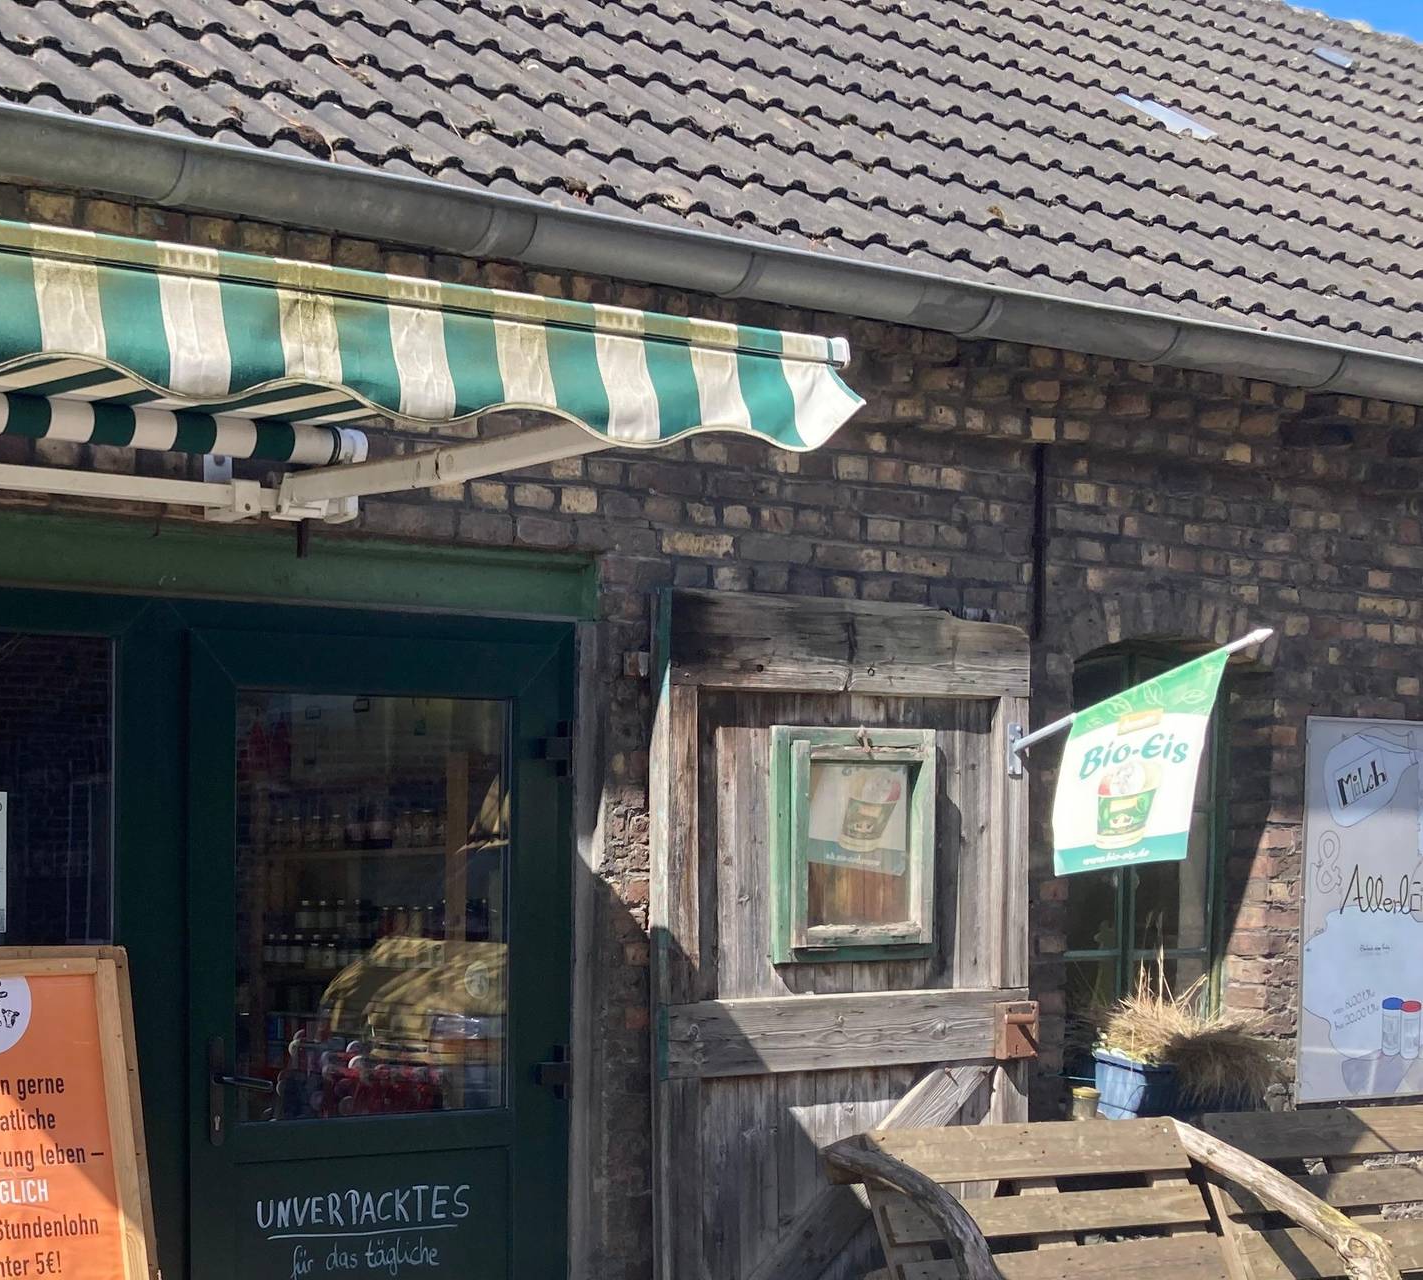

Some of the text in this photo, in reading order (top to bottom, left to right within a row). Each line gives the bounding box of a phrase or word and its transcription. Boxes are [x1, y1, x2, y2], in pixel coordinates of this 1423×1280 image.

[1079, 733, 1189, 780] Bio-Eis
[1337, 760, 1388, 806] Milch
[17, 1076, 65, 1101] gerne
[40, 1143, 86, 1166] leben
[257, 1184, 470, 1229] UNVERPACKTES
[36, 1250, 62, 1276] 5€!
[291, 1236, 440, 1280] für das tägliche
